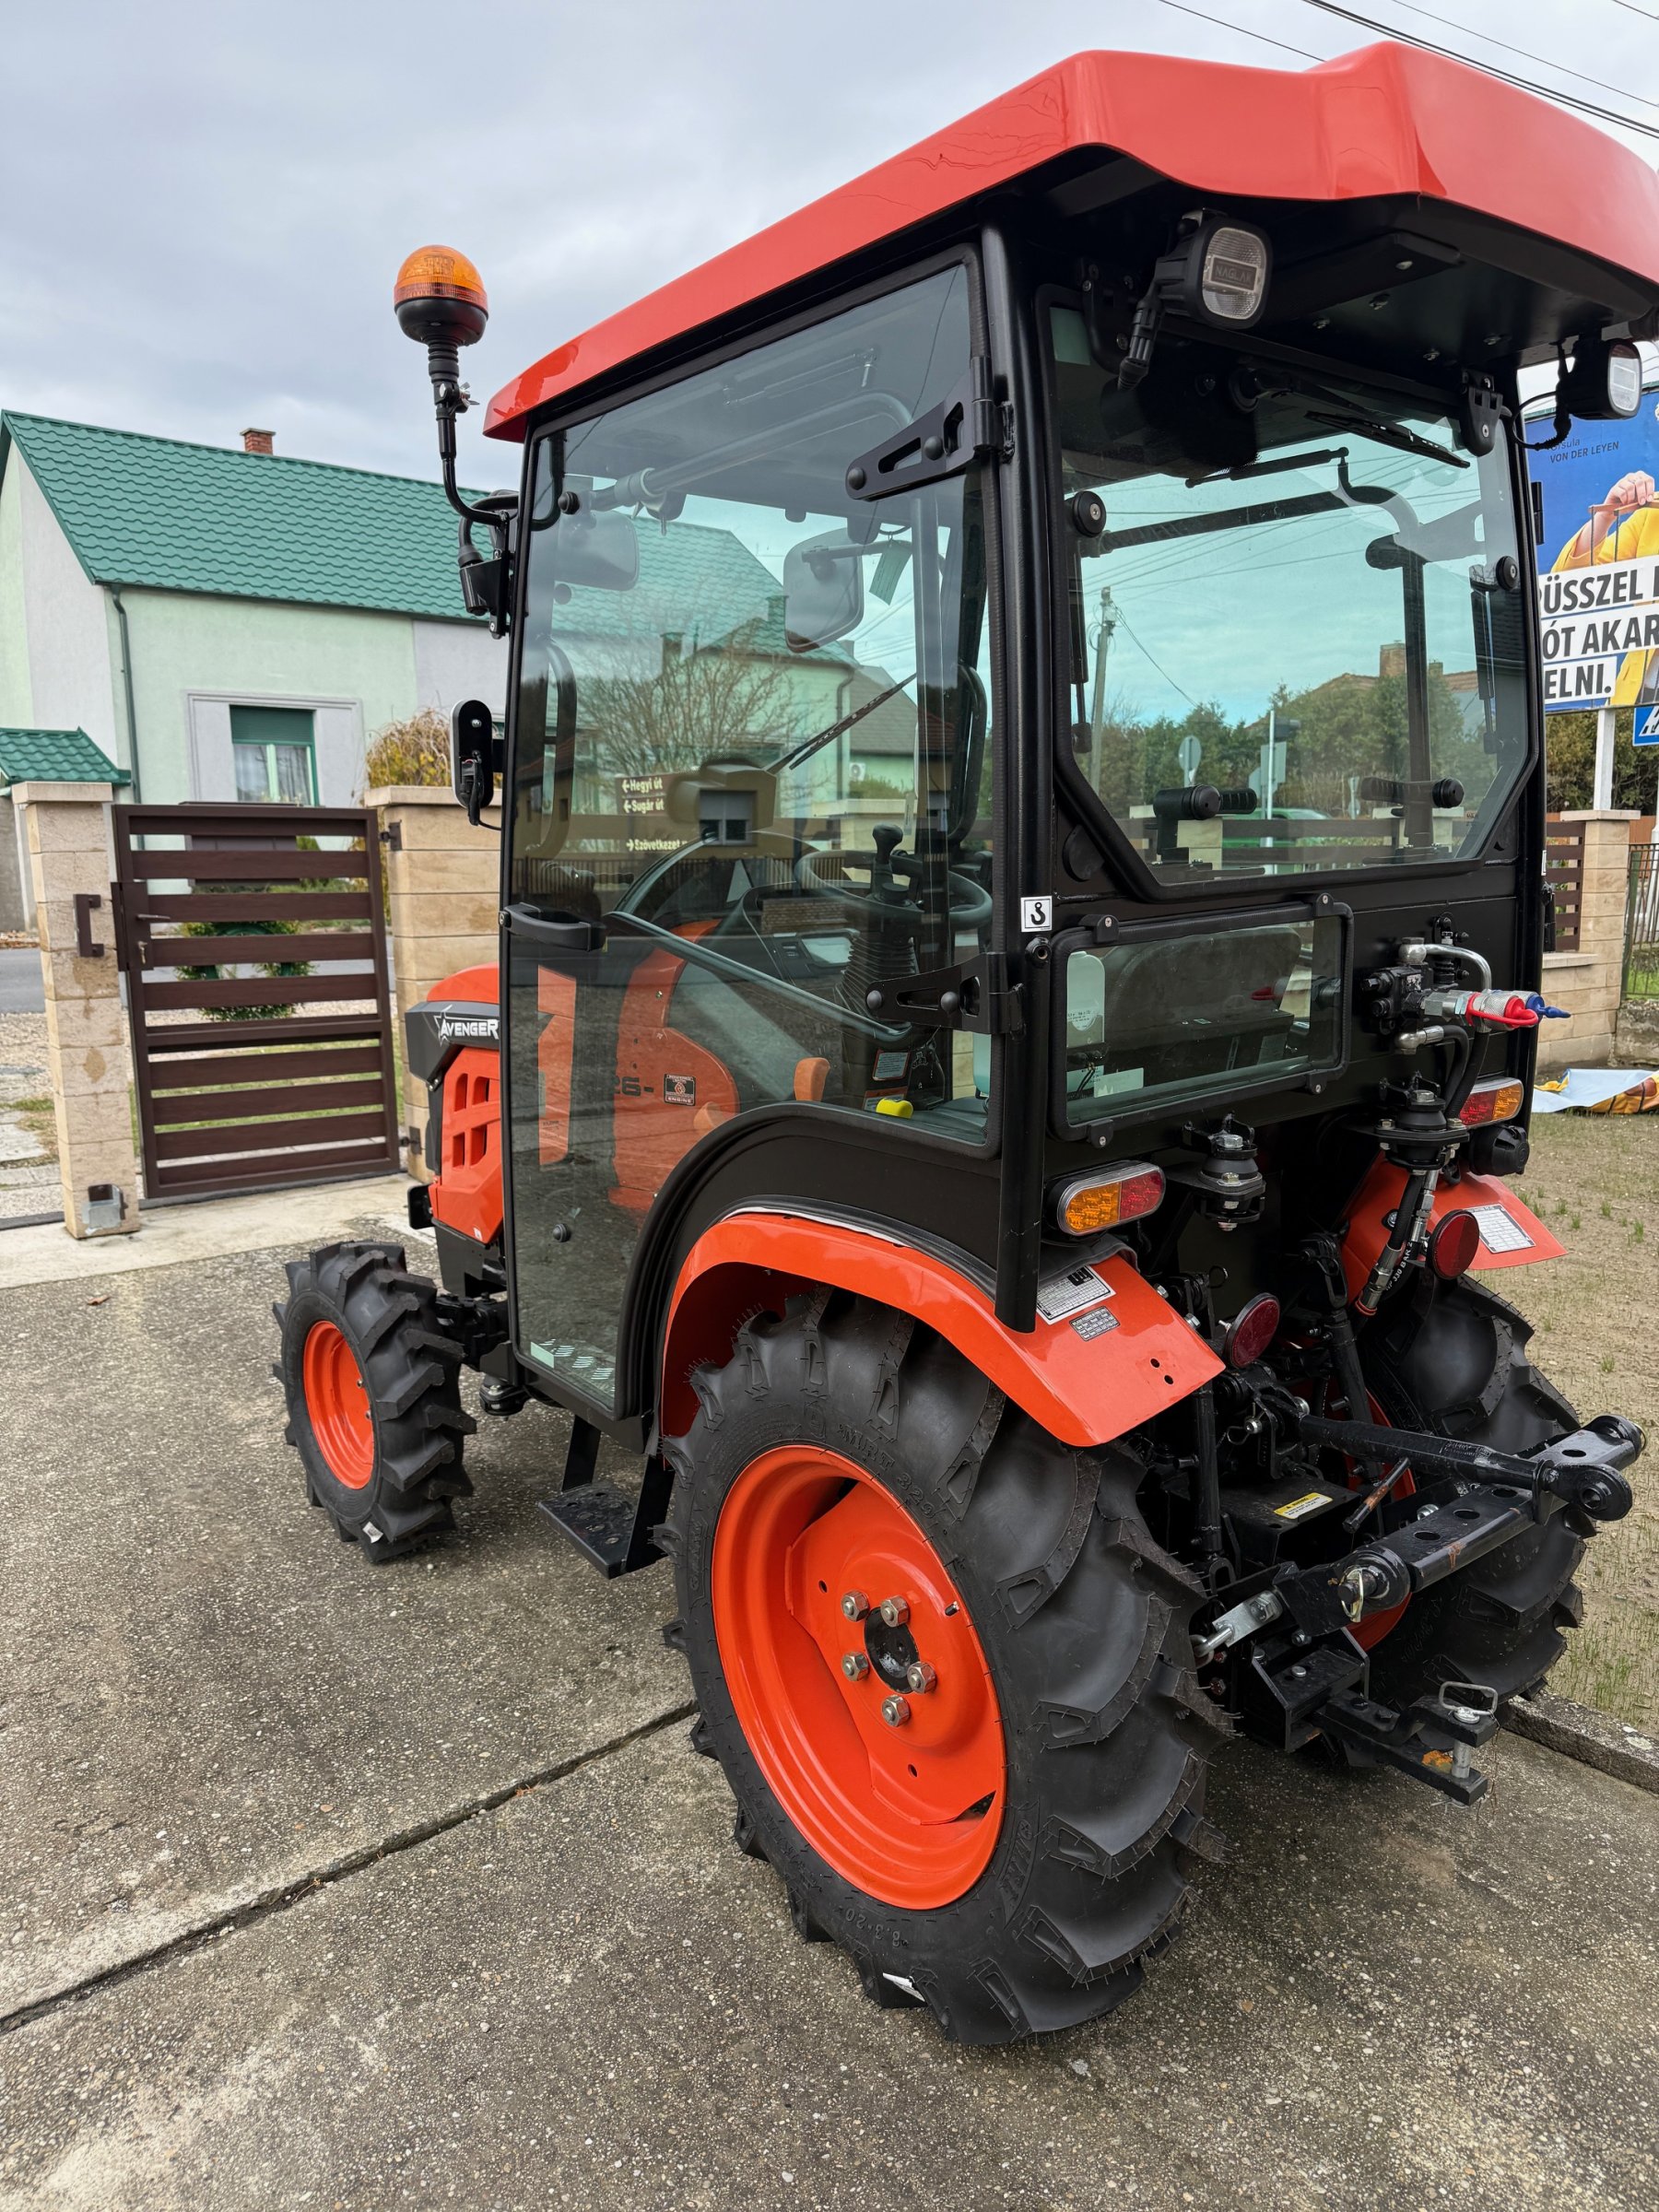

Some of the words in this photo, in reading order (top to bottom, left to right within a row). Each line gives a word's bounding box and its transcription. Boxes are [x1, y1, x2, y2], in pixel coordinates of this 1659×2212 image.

[1549, 452, 1569, 464] VON
[1571, 448, 1589, 459] DER
[1591, 441, 1619, 455] LEYEN
[1539, 569, 1644, 615] ÜSSZEL
[1581, 613, 1659, 655] AKAR
[1545, 663, 1612, 700] ELNI.
[629, 777, 653, 794] Hegyi
[653, 777, 663, 790] út
[631, 799, 654, 814] Sugár
[655, 798, 665, 811] út
[634, 839, 680, 851] Szövetkezet
[441, 1018, 500, 1040] AVENGER
